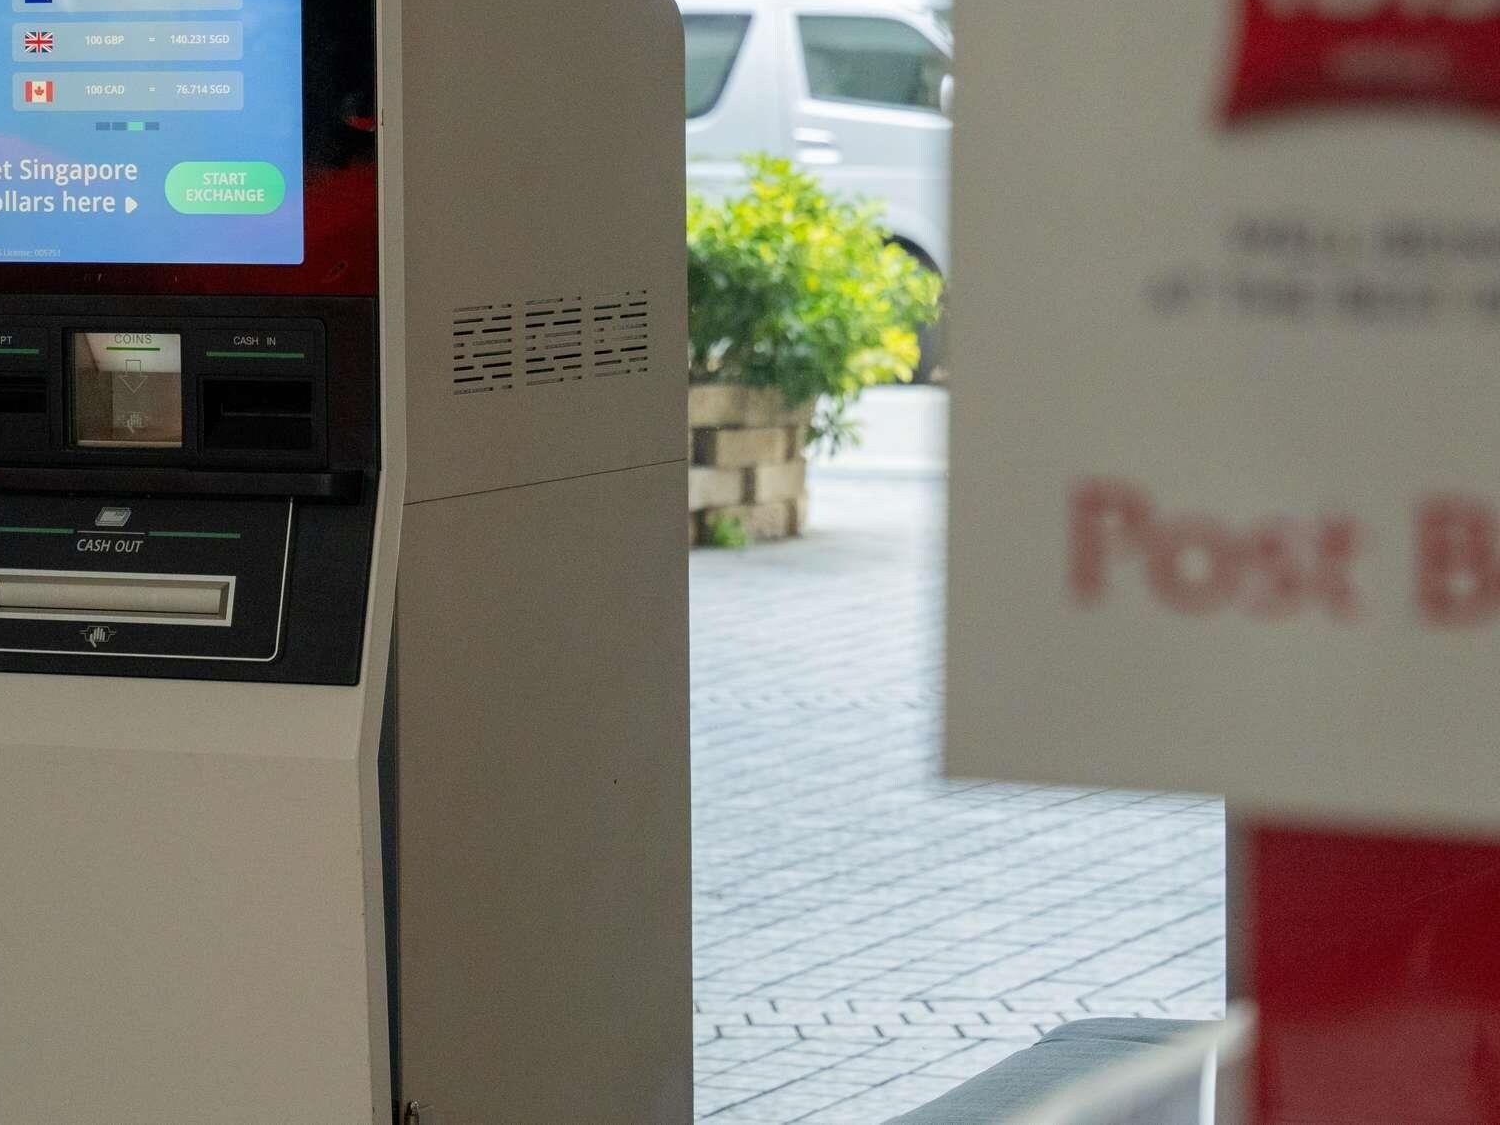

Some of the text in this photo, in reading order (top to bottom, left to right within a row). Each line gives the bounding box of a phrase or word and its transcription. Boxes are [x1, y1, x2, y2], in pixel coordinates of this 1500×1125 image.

[85, 36, 102, 45] 100
[209, 34, 229, 44] SGD
[85, 85, 102, 95] 100
[210, 85, 230, 94] SGD
[19, 159, 138, 186] Singapore
[203, 172, 247, 186] START
[63, 191, 116, 212] here
[185, 188, 265, 202] EXCHANGE
[114, 333, 152, 345] COINS
[233, 336, 276, 346] CASH IN
[76, 539, 144, 553] CASH OUT
